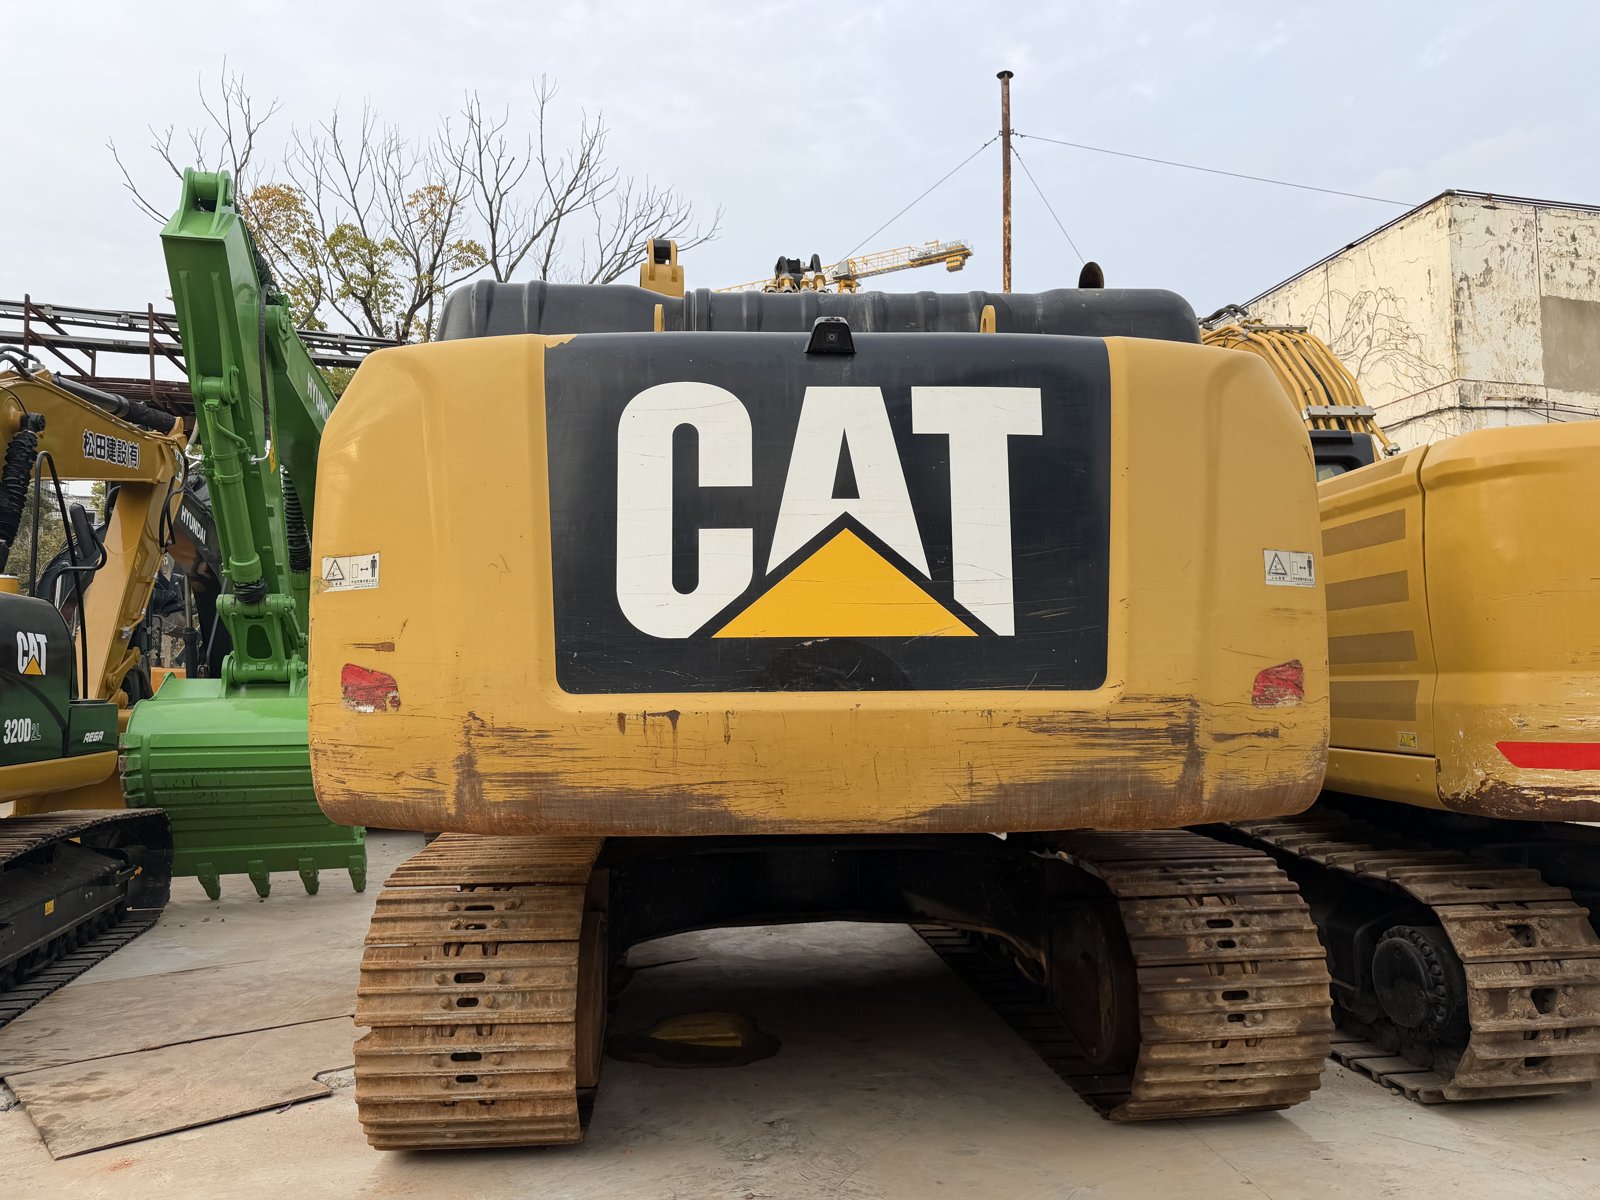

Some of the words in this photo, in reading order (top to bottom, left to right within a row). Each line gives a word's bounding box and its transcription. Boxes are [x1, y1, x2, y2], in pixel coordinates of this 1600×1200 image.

[307, 371, 331, 423] HYUND
[181, 505, 207, 545] HYUNDAI
[616, 381, 1043, 639] CAT
[16, 631, 48, 676] CAT
